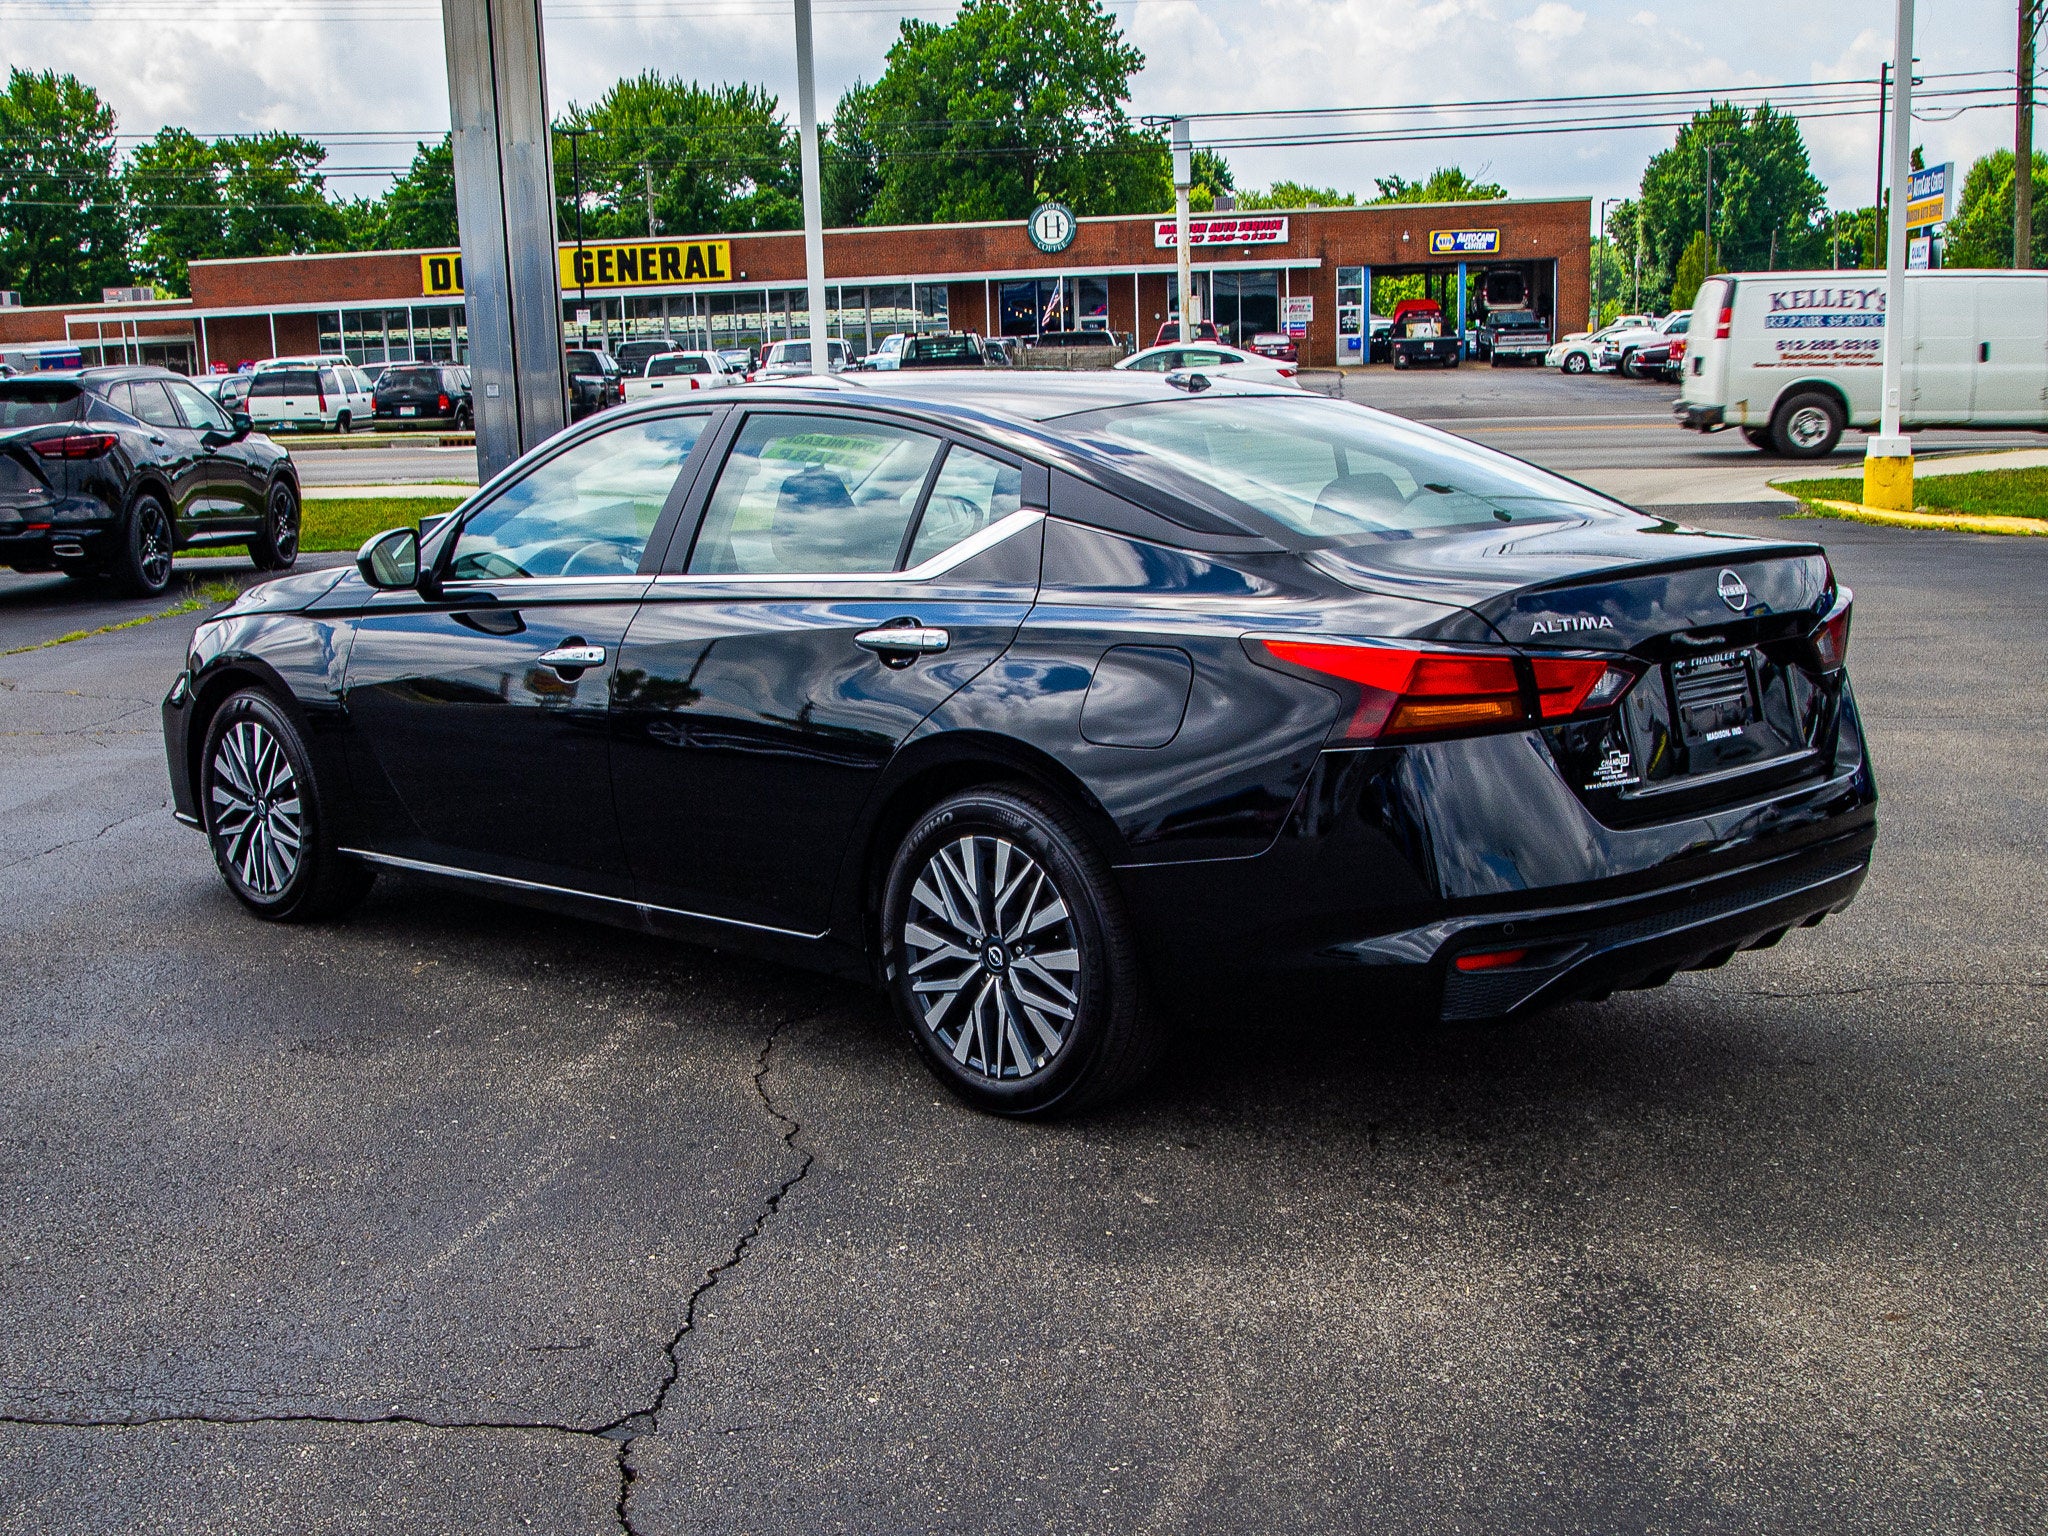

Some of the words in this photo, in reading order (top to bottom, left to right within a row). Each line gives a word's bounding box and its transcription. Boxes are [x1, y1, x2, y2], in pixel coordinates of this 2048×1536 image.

[1158, 223, 1207, 235] MAON
[1208, 220, 1237, 233] AUTO
[1238, 219, 1284, 232] SERVICE
[1457, 232, 1495, 243] AUTOCARE
[1037, 240, 1068, 252] COFFEE
[1464, 242, 1487, 250] CENTER
[573, 244, 726, 284] GENERAL
[1766, 315, 1824, 328] REPAIR
[1828, 313, 1885, 328] SERVIC
[1718, 585, 1748, 597] NISSAN
[1530, 616, 1613, 636] ALTIMA
[1691, 651, 1736, 667] CHANDLER
[1601, 757, 1627, 768] CHANDLER
